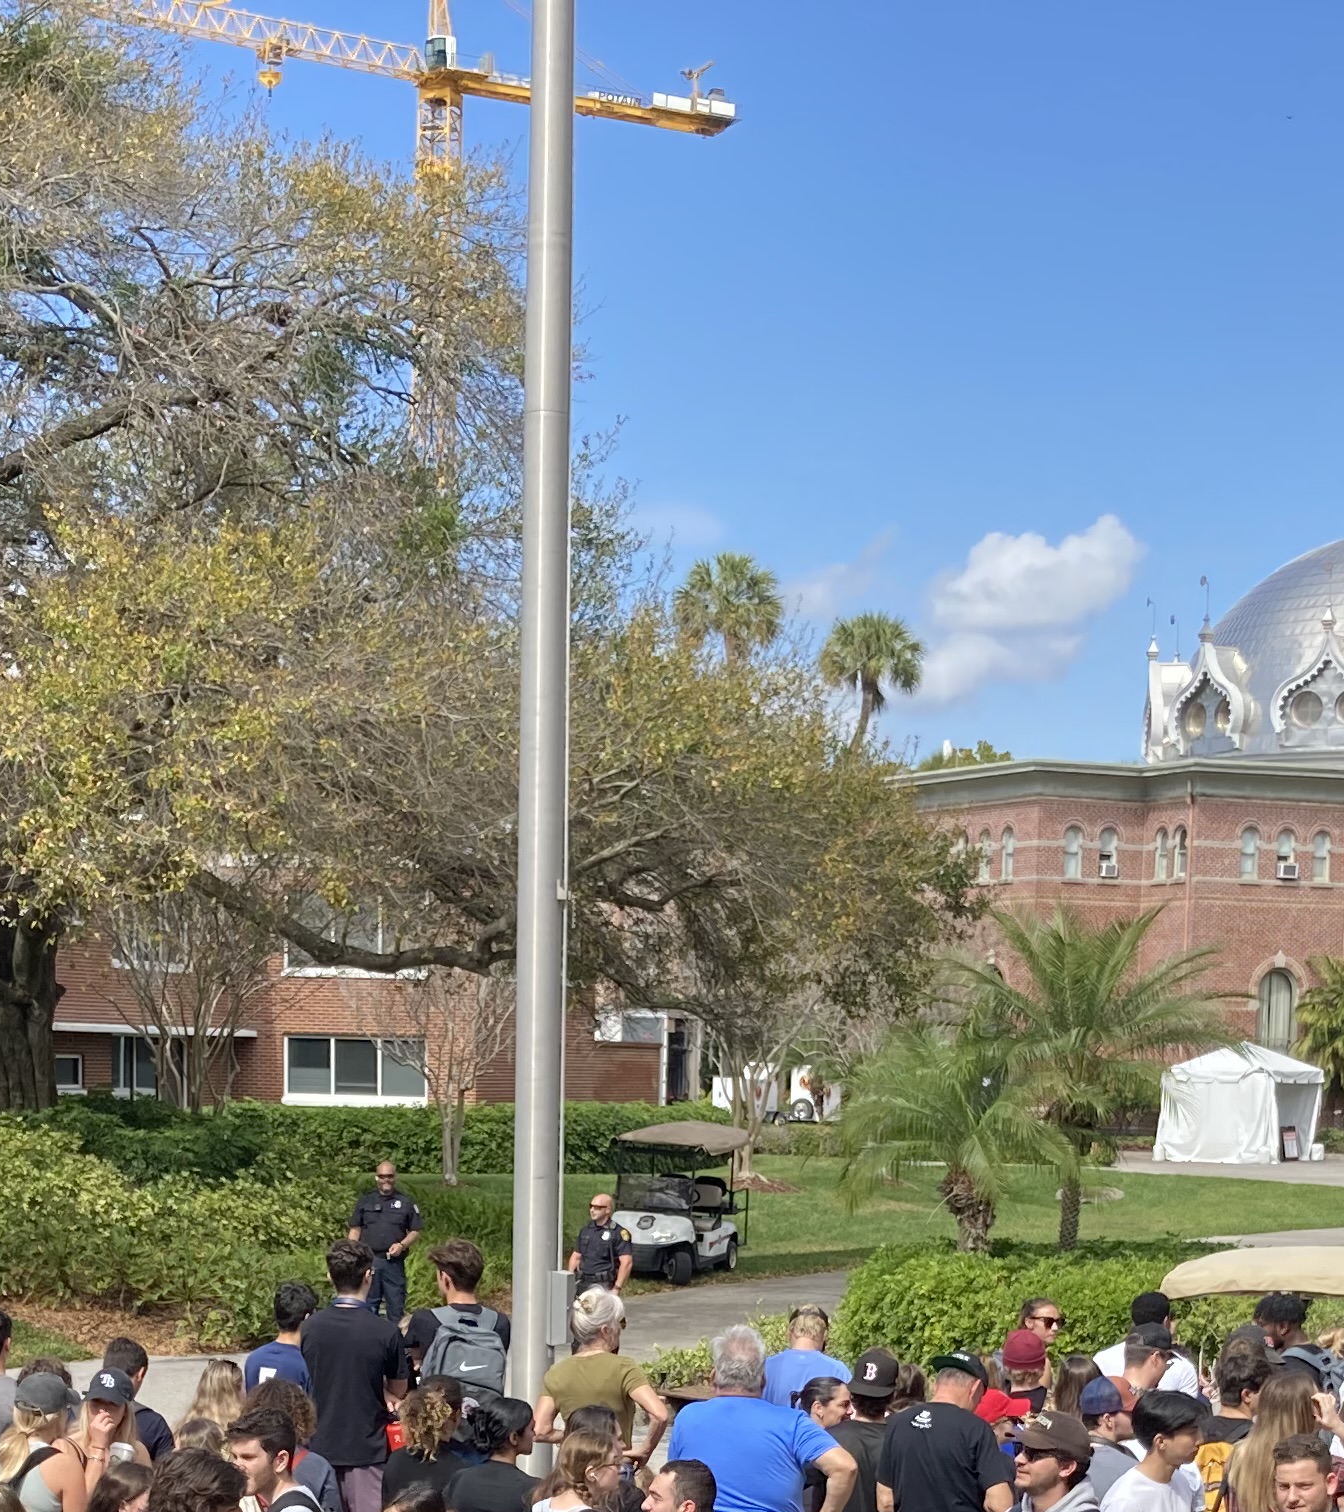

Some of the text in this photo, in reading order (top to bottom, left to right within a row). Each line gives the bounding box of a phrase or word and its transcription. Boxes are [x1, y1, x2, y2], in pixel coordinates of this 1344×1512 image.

[598, 91, 642, 106] POTAIN
[863, 1362, 877, 1380] B
[100, 1373, 115, 1387] TB
